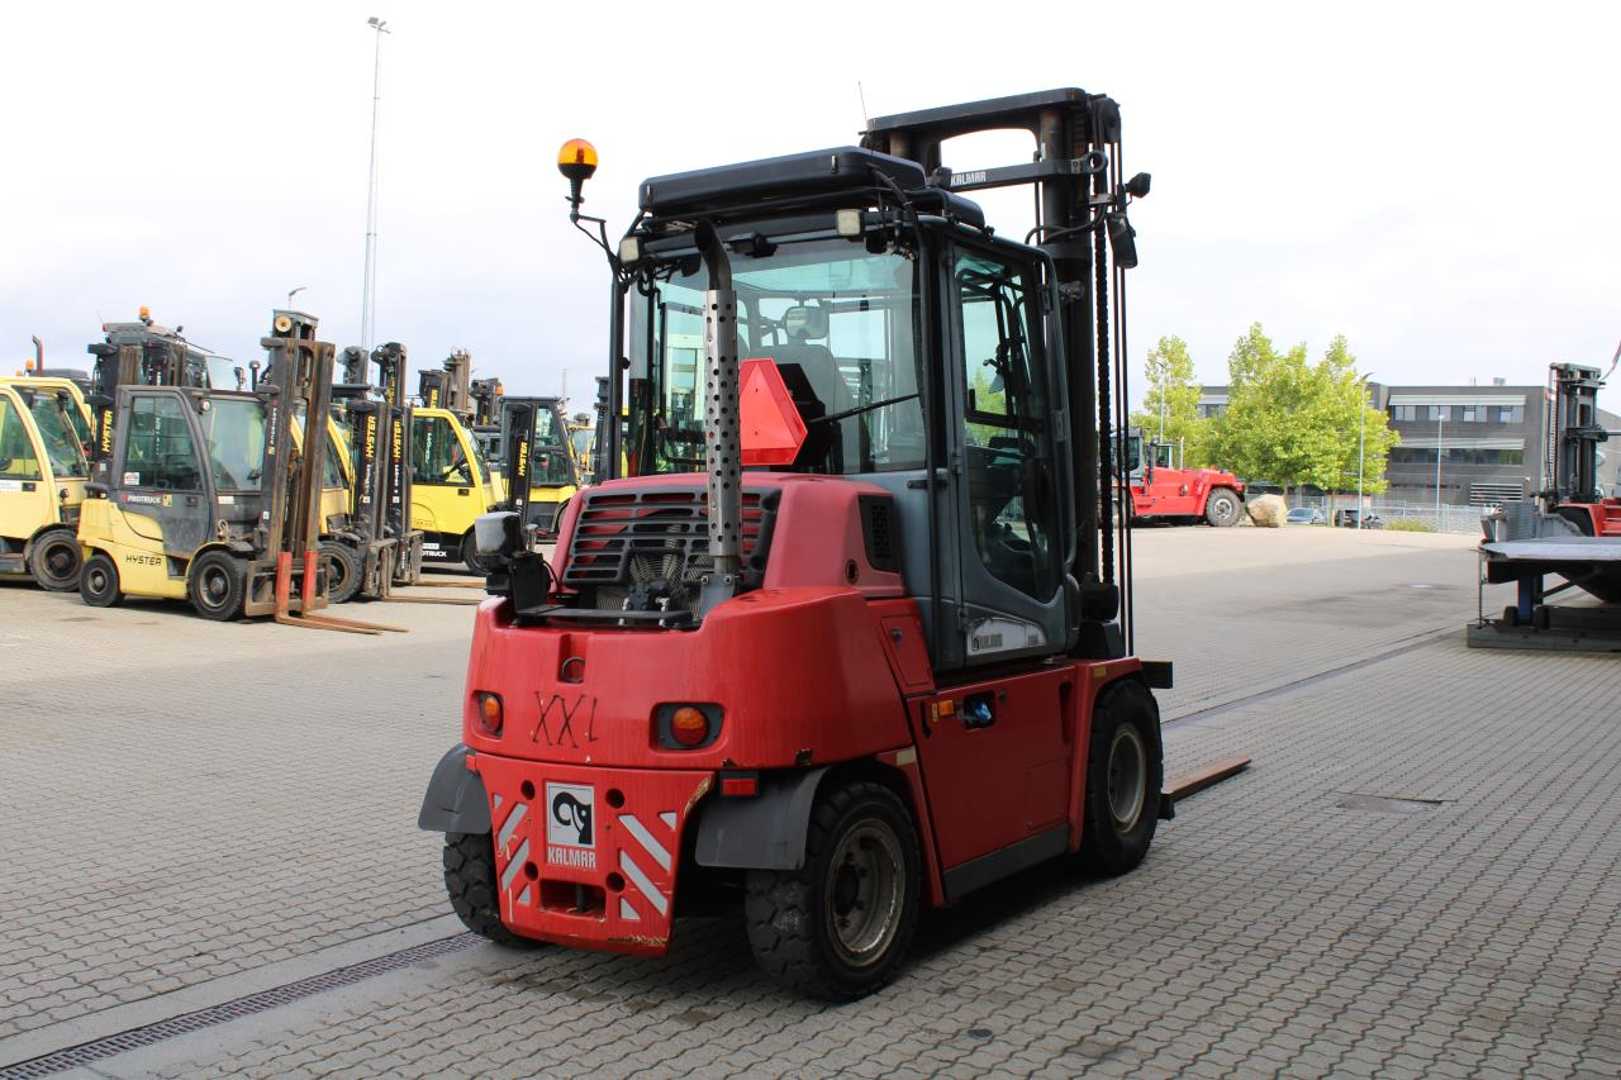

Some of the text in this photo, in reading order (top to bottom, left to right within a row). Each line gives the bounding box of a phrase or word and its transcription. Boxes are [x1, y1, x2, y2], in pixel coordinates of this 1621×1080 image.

[950, 171, 986, 186] KALMAR
[101, 410, 113, 452] HYSTER
[366, 416, 376, 458] HYSTER
[393, 421, 401, 458] HYSTER
[518, 441, 528, 477] HYSTER
[126, 554, 161, 566] HYSTER
[532, 690, 599, 748] XXL
[547, 846, 597, 869] KALMAR
